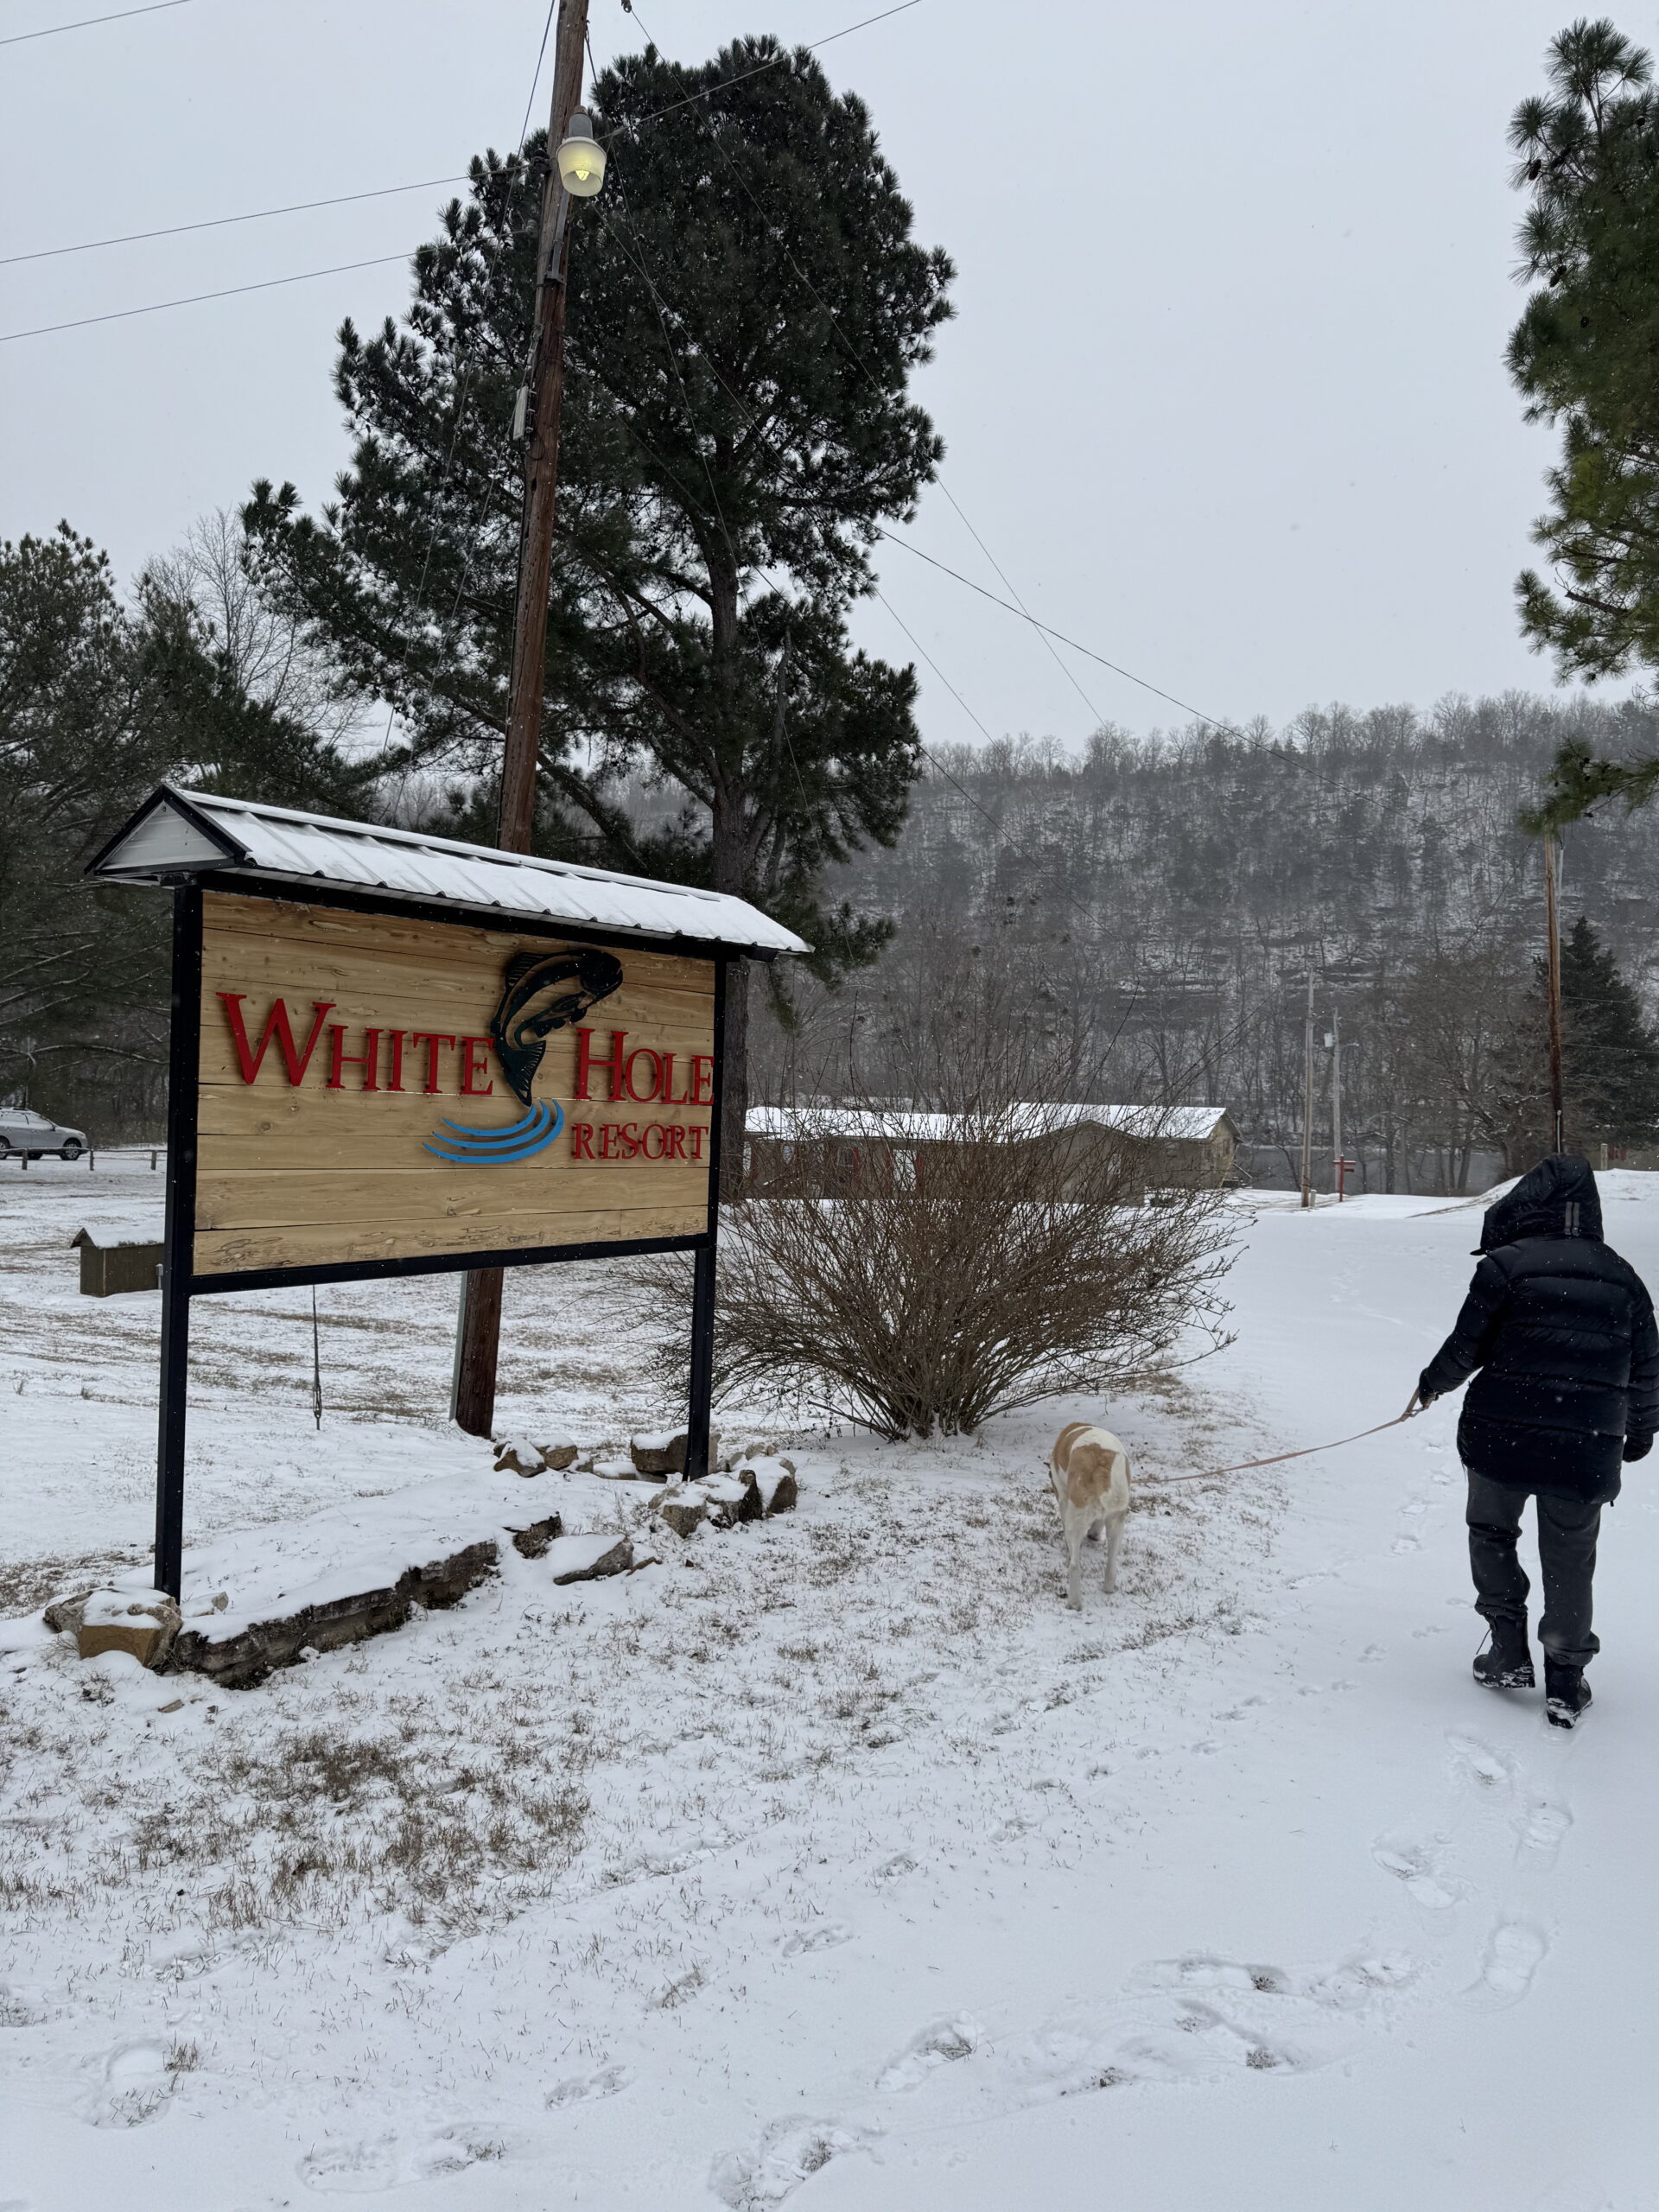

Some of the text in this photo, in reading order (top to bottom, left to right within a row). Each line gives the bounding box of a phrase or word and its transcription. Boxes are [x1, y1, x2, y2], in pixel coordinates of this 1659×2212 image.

[217, 992, 715, 1106] WHITE HOLE
[572, 1122, 709, 1160] RESORT
